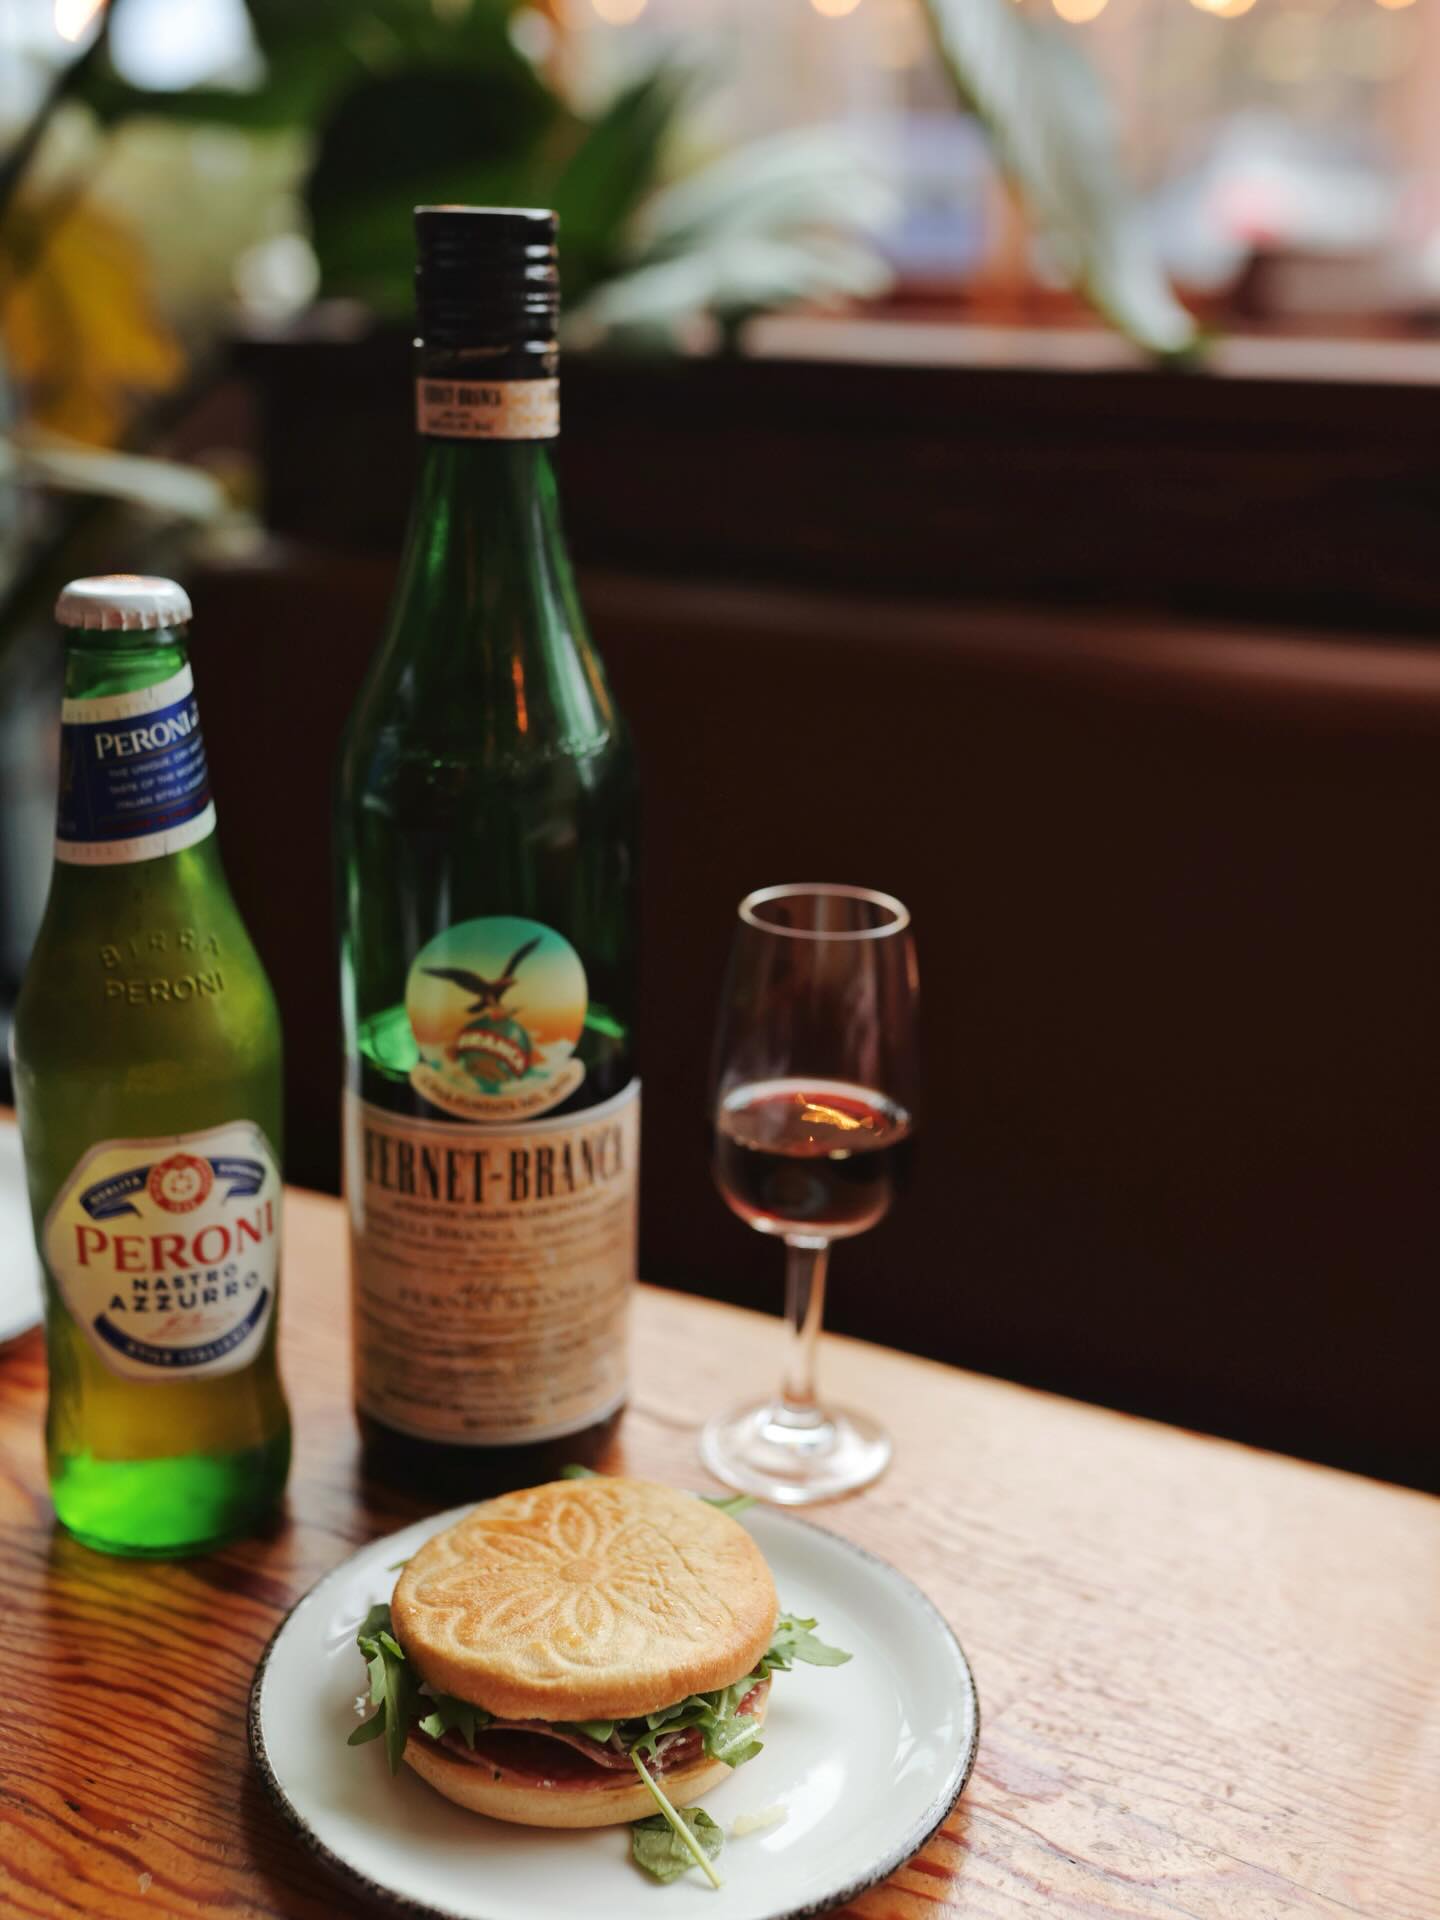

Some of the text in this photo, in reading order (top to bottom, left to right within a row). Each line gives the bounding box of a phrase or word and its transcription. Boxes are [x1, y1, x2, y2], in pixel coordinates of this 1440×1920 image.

[105, 966, 225, 1005] PERONI
[74, 1200, 274, 1274] PERONI
[109, 1271, 259, 1313] AZZURRO
[132, 1264, 237, 1292] NASTRO
